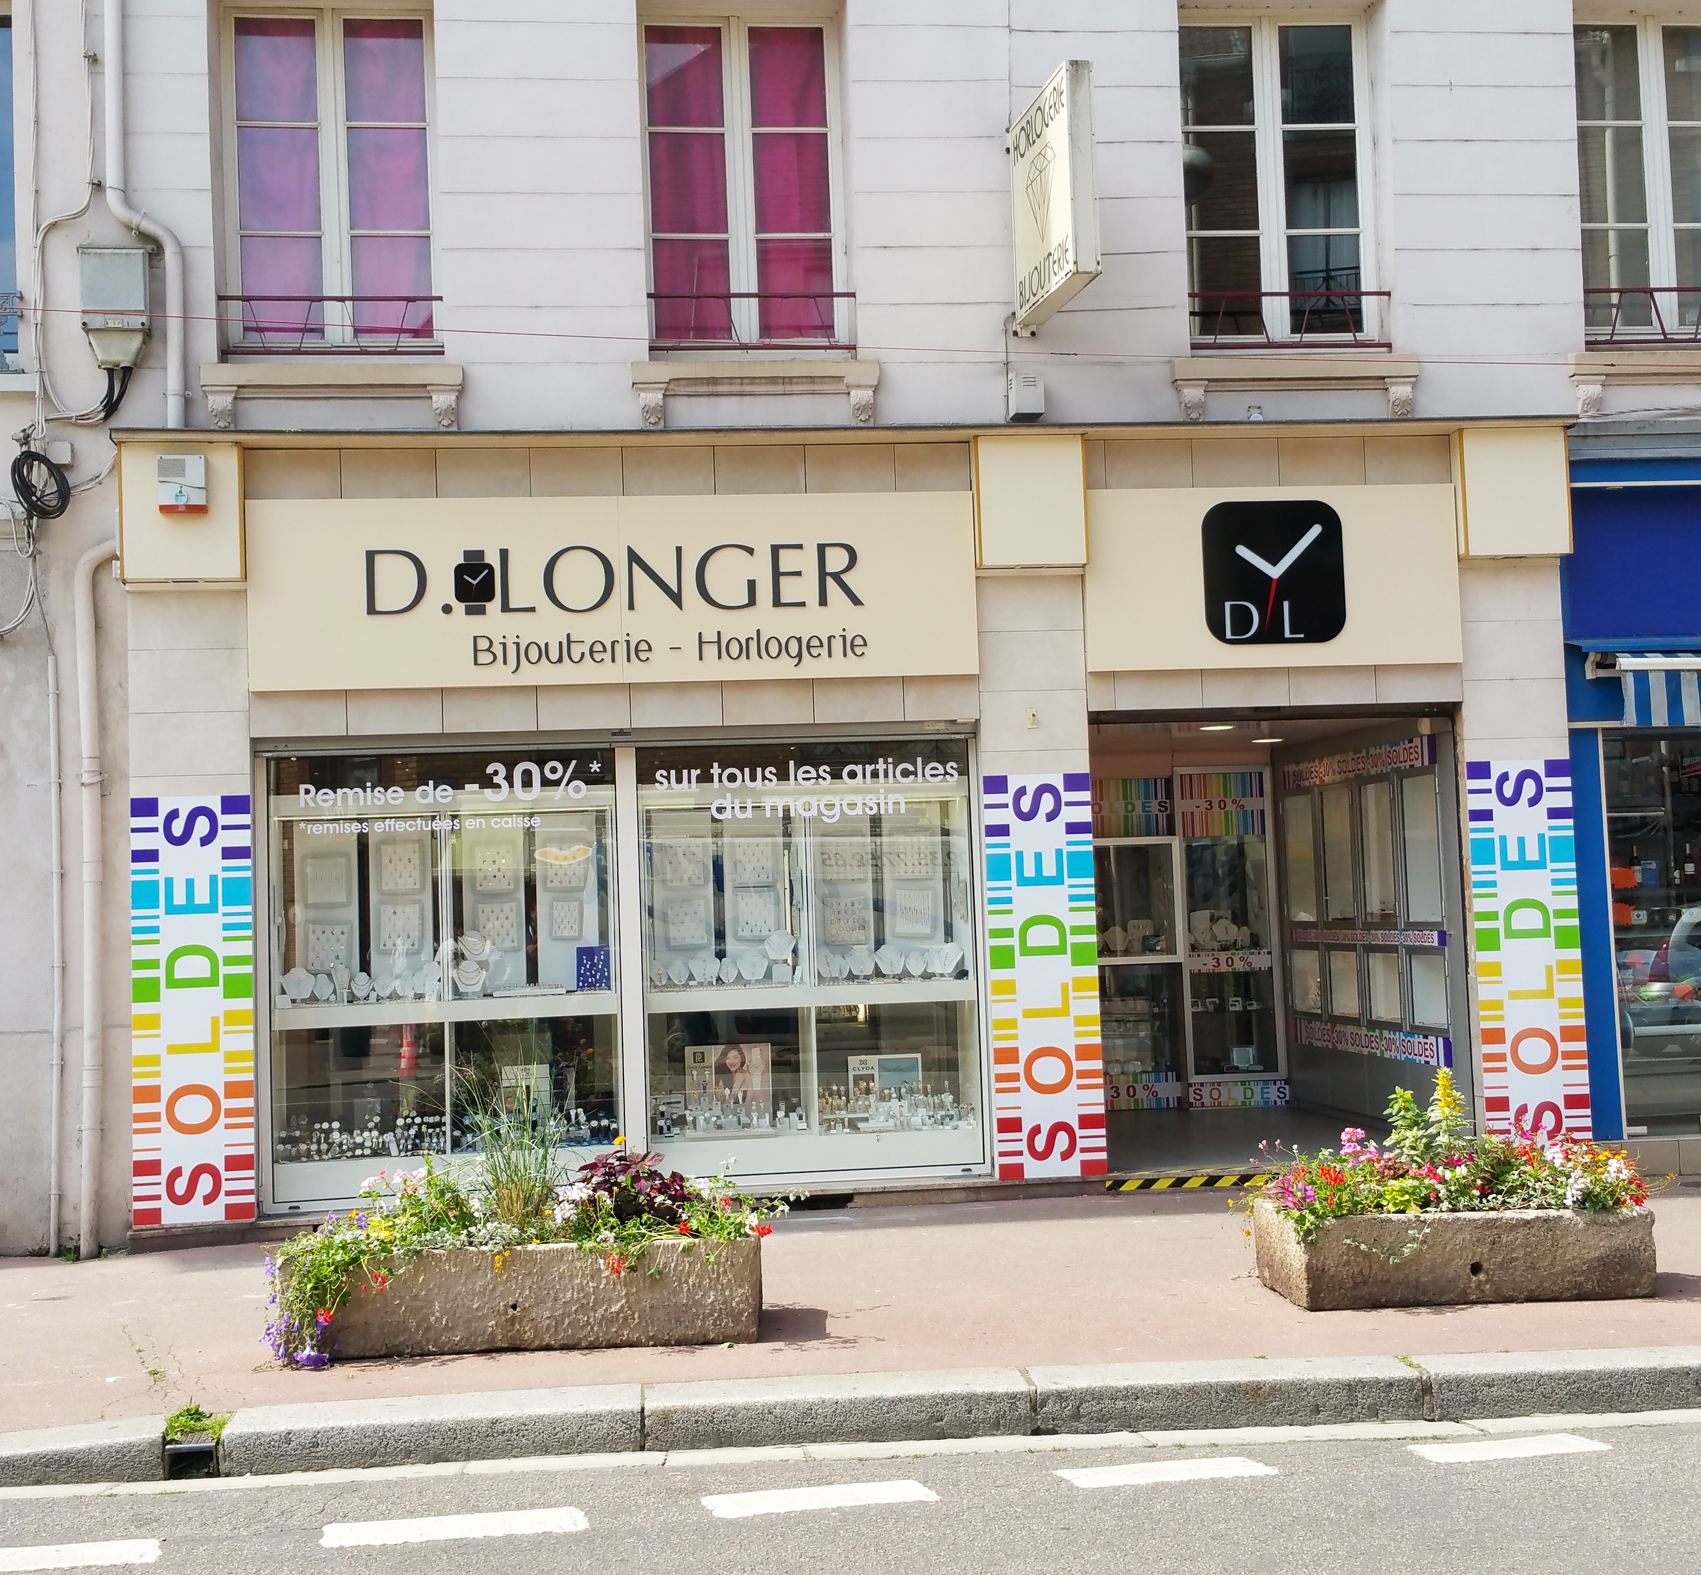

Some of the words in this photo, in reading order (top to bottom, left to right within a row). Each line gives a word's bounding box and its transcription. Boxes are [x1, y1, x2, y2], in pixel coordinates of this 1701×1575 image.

[1012, 76, 1065, 167] HORLOGERIE
[1018, 233, 1070, 311] BIJOUTERIE
[472, 632, 653, 673] Bijouterie
[697, 628, 868, 667] Horlogerie
[655, 769, 701, 791] sur
[710, 762, 778, 789] tous
[789, 760, 832, 787] les
[842, 757, 959, 784] articles
[1337, 755, 1366, 775] SOLDES
[1368, 752, 1386, 769] -30%
[1387, 744, 1420, 766] SOLDES
[298, 783, 405, 807] Remise
[415, 780, 454, 804] de
[711, 792, 753, 820] du
[765, 788, 906, 823] magasin
[1090, 800, 1169, 815] OLDES
[1195, 798, 1246, 811] -30%
[374, 815, 461, 833] effectuées
[465, 818, 486, 829] en
[490, 814, 541, 828] caisse
[1380, 932, 1400, 943] SOLDES
[1413, 932, 1435, 944] SOLDES
[1495, 768, 1564, 1141] SOLDES
[1012, 783, 1077, 1162] SOLDES
[1202, 955, 1253, 968] -30%
[163, 804, 222, 1206] SOLDES
[1305, 1023, 1332, 1043] SOLDES
[1332, 1028, 1349, 1047] -30%
[1350, 1031, 1380, 1051] SOLDES
[1381, 1035, 1400, 1055] -30%
[1401, 1038, 1436, 1060] SOLDES
[1192, 1086, 1287, 1102] SOLDES
